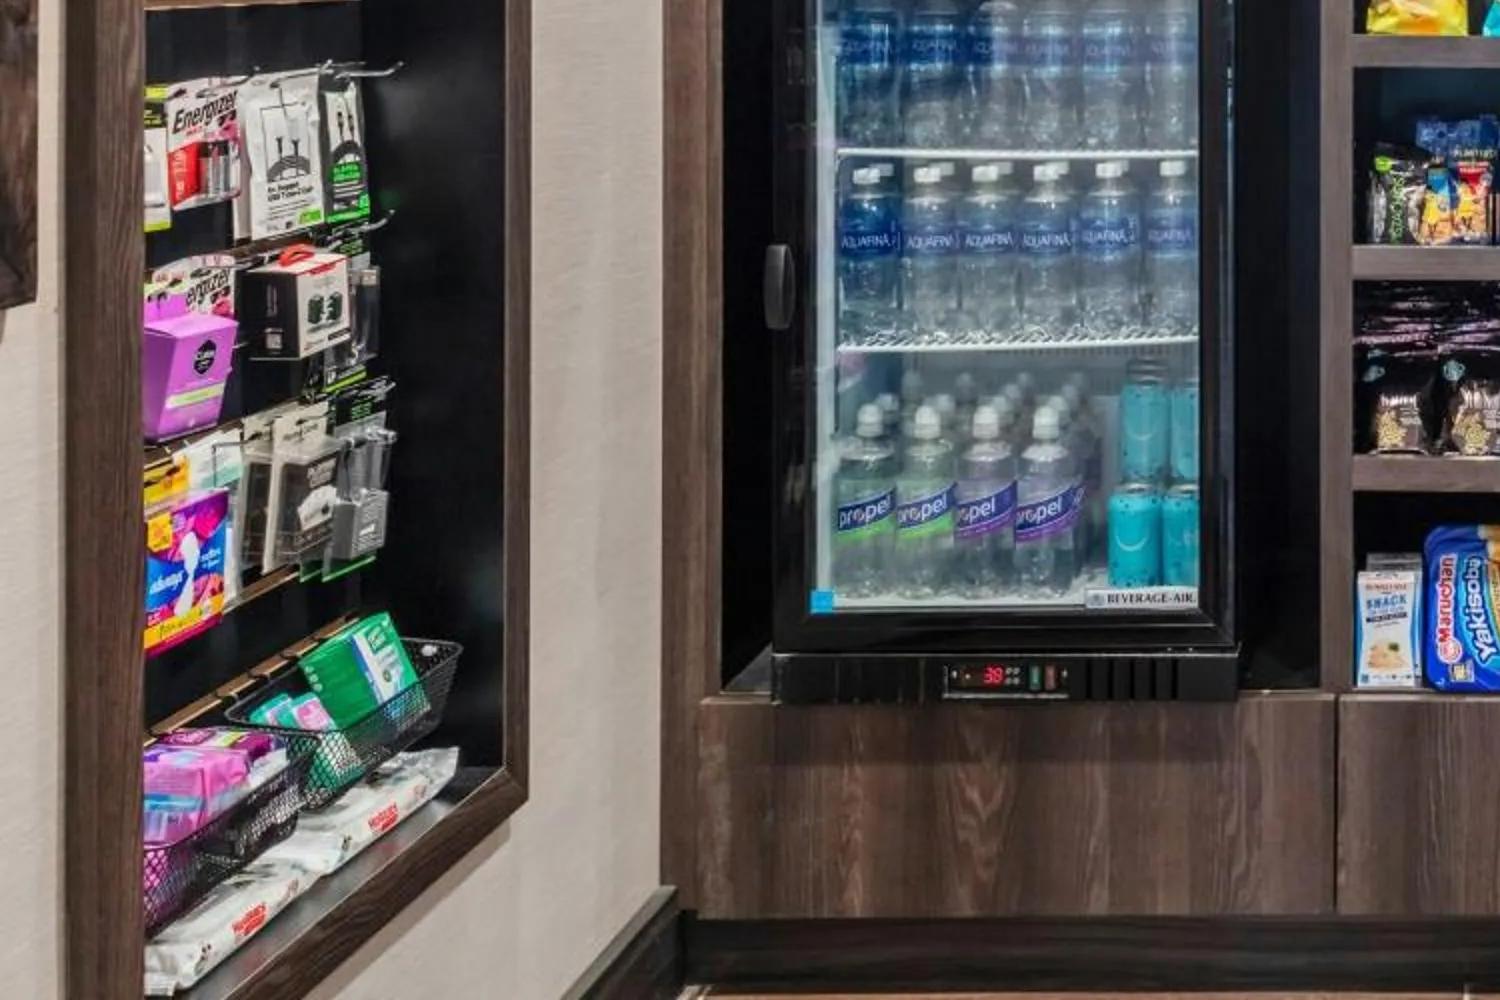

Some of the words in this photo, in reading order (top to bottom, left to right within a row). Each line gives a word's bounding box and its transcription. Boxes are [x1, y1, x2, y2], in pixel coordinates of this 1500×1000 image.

[172, 89, 238, 135] Energizer
[839, 494, 892, 529] propel
[959, 496, 996, 523] opel
[1437, 556, 1455, 643] Maruchan
[1465, 556, 1498, 661] Yakisoba
